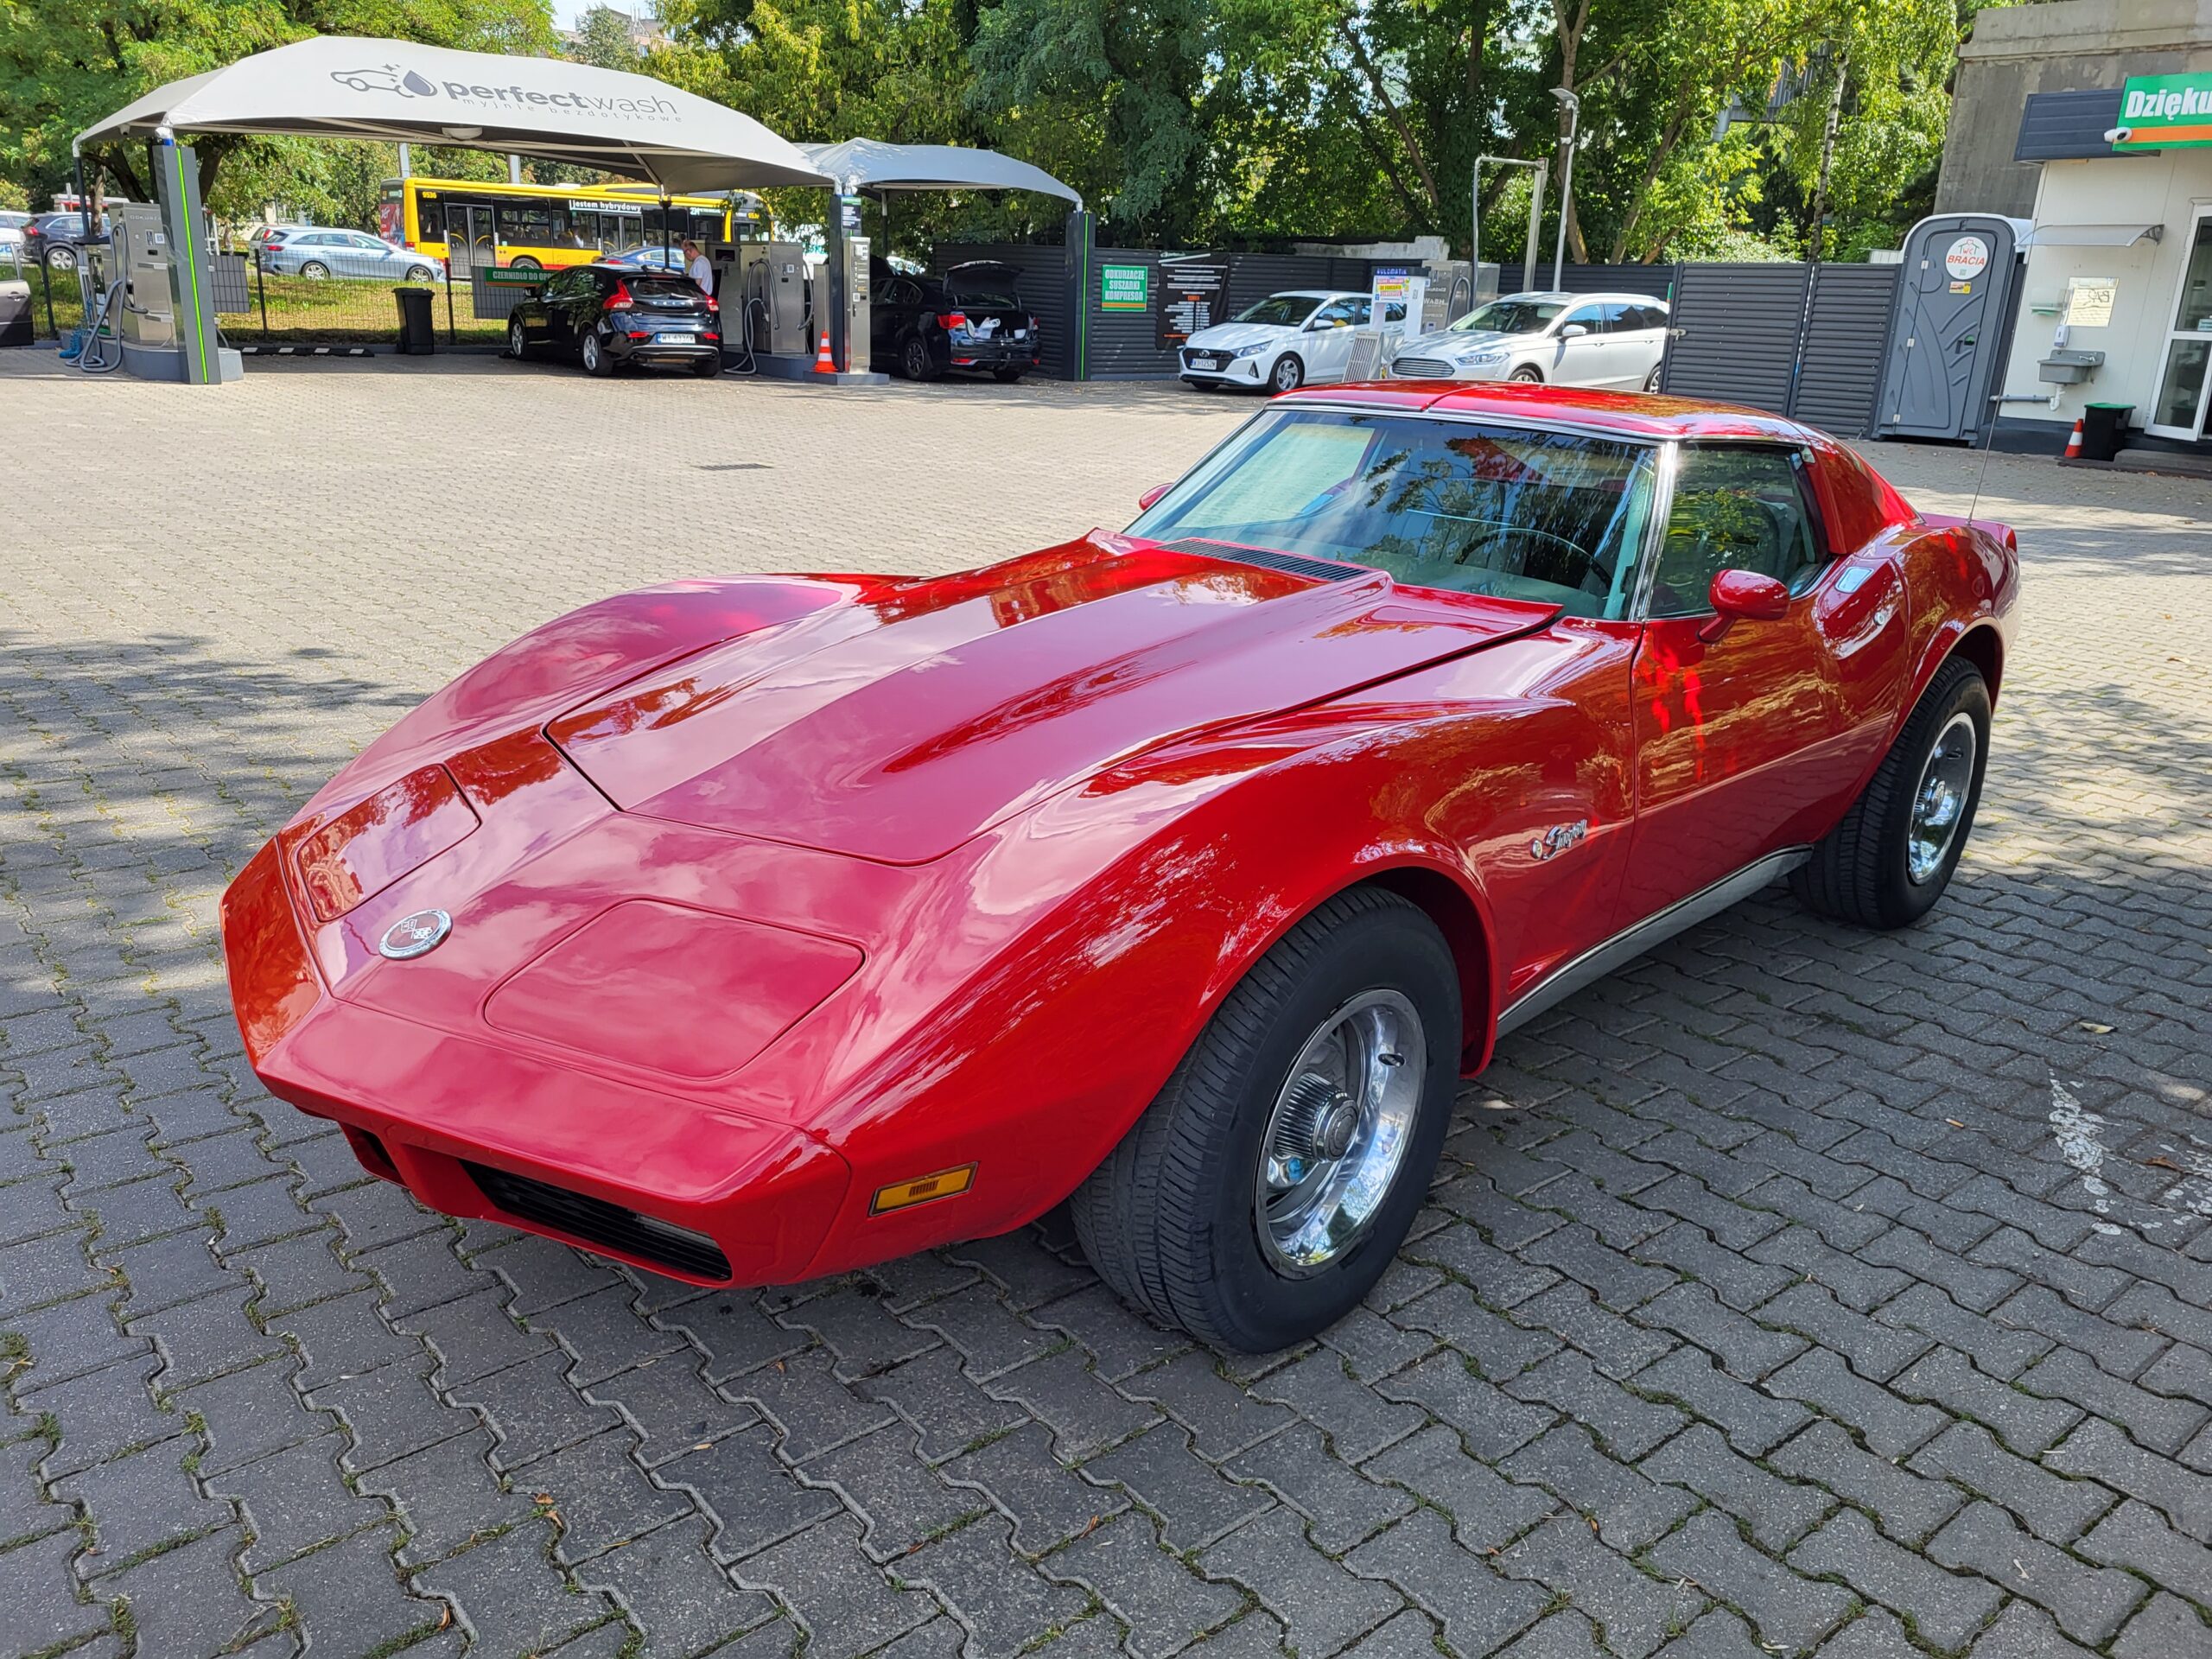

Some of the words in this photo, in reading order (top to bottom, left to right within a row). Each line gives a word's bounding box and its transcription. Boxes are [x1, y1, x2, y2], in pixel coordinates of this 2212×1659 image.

[442, 81, 677, 114] perfectwash
[2125, 87, 2212, 120] Dzięku
[463, 99, 536, 111] myjnie
[549, 106, 683, 122] bezdotykowe
[600, 201, 642, 212] hybrydowy
[1947, 255, 1986, 266] BRACIA
[493, 270, 528, 280] CZERNIDŁO
[1105, 269, 1146, 281] ODKURZACZE
[1109, 280, 1141, 290] SUSZARKI
[1104, 290, 1144, 302] KOMPRESOR
